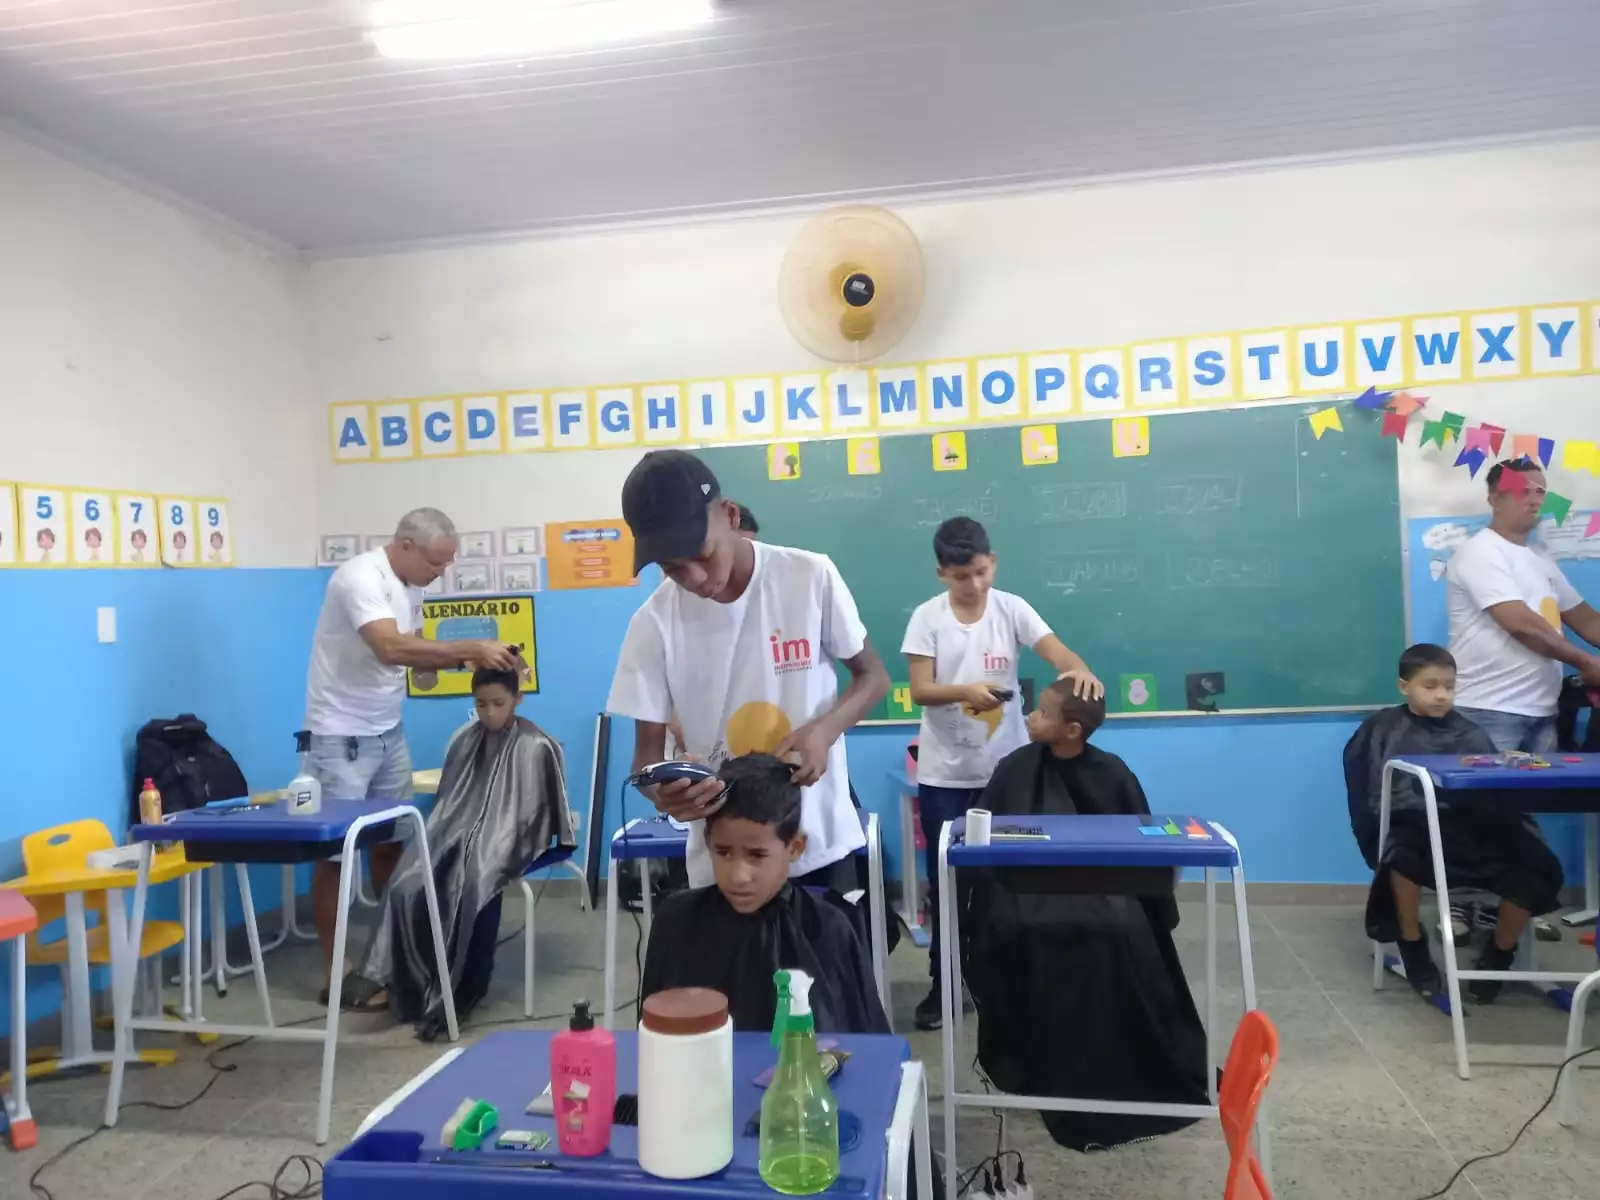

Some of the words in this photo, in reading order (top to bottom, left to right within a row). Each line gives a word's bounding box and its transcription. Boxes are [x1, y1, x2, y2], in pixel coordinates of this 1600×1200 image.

[341, 418, 365, 446] A
[382, 416, 407, 446] B
[425, 412, 450, 442] C
[468, 409, 495, 439] D
[514, 405, 538, 437] E
[558, 403, 582, 435] F
[601, 401, 631, 432] G
[648, 397, 676, 429] H
[702, 394, 713, 426] I
[743, 390, 766, 423] J
[786, 386, 816, 420] K
[838, 383, 861, 416] L
[880, 380, 916, 414] M
[932, 375, 963, 409] N
[981, 370, 1016, 404] O
[1035, 367, 1066, 401] P
[1084, 363, 1120, 399] Q
[1139, 357, 1173, 392] R
[1194, 350, 1226, 386] S
[1248, 345, 1281, 381] T
[1304, 341, 1339, 376] U
[1361, 336, 1396, 372] V
[1416, 331, 1460, 366] W
[1478, 326, 1514, 363] X
[1538, 320, 1575, 358] Y
[1116, 422, 1141, 453] U
[854, 440, 876, 473] E
[35, 495, 53, 520] 5
[84, 499, 100, 521] 6
[130, 502, 143, 523] 7
[171, 504, 184, 526] 8
[207, 507, 219, 527] 9
[769, 635, 811, 663] im
[984, 652, 1010, 670] im
[893, 687, 913, 712] 4
